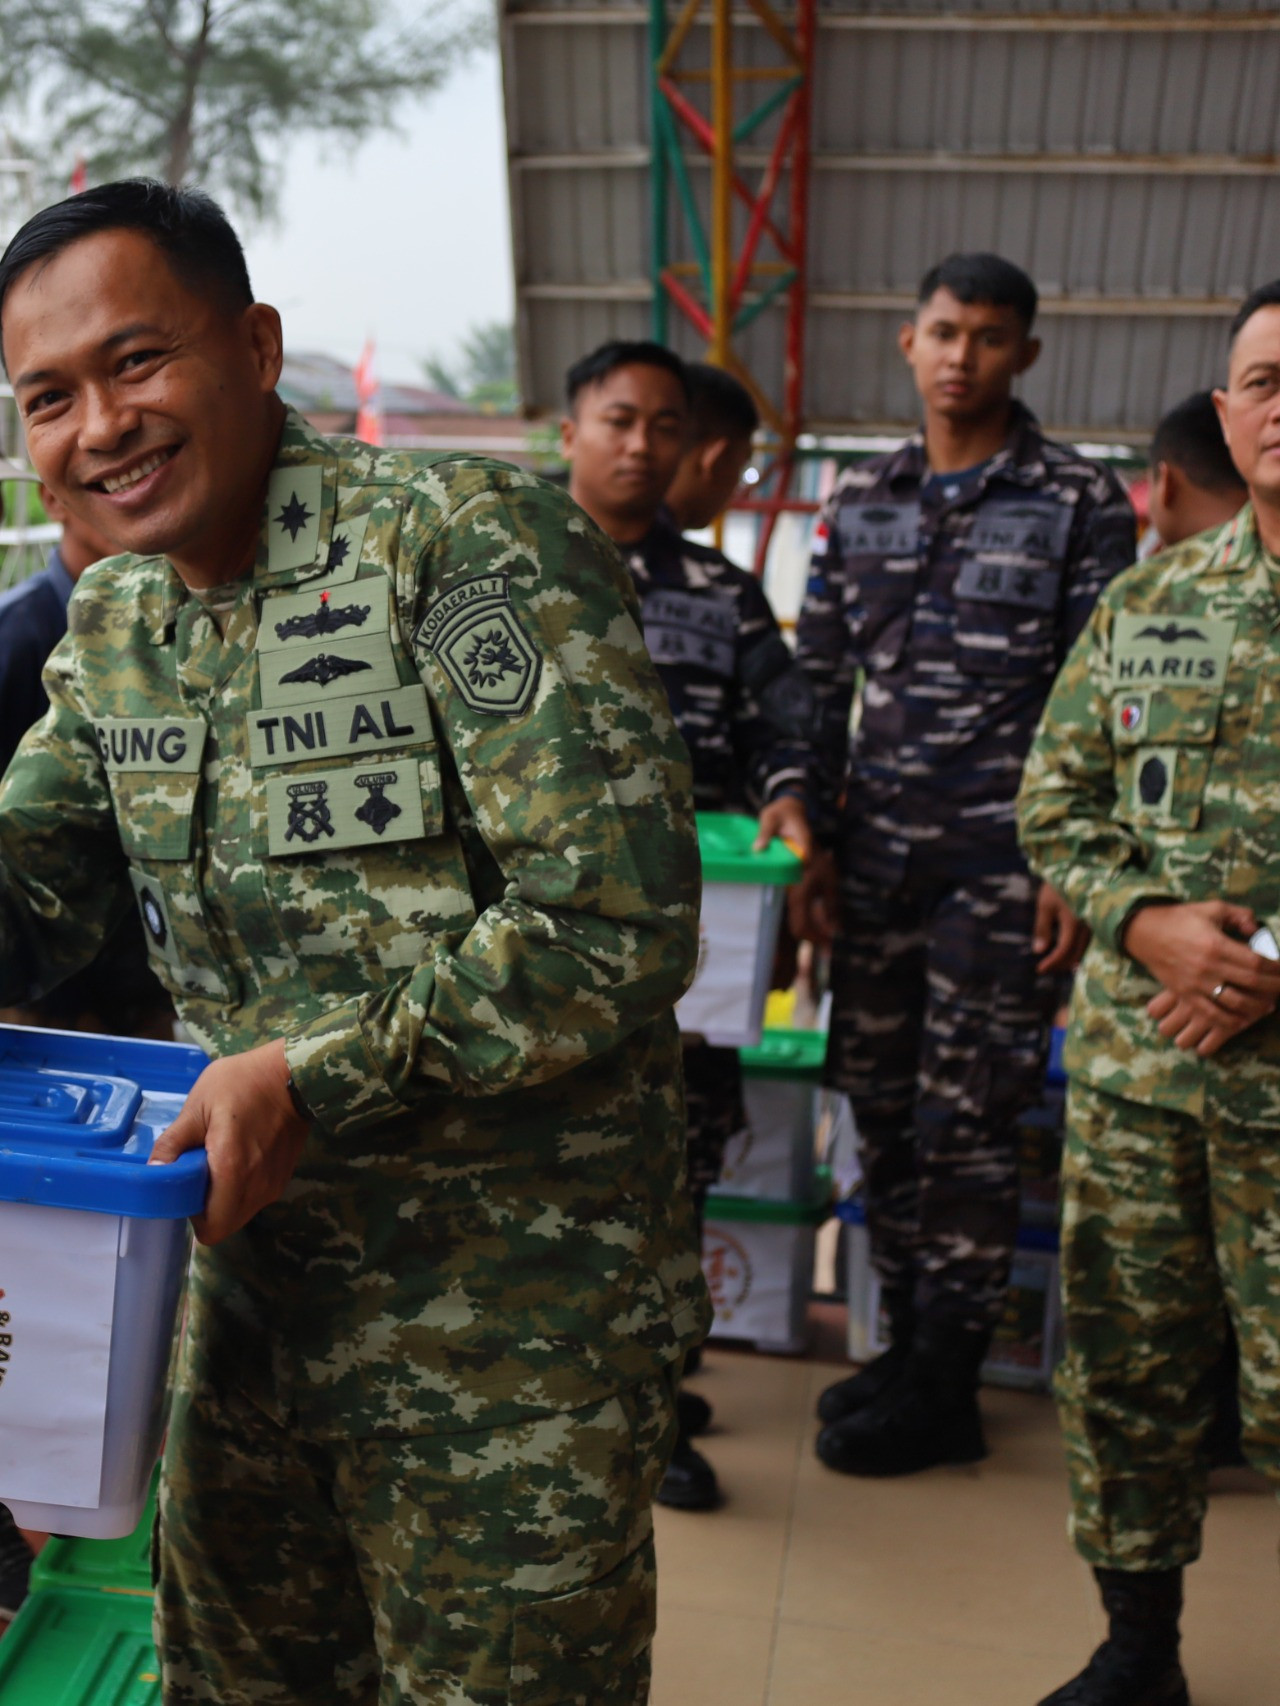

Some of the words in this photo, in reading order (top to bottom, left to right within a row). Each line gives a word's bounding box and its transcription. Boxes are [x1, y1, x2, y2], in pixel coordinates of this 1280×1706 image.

[420, 582, 488, 640] KODAERAL
[1119, 656, 1216, 679] HARIS
[256, 711, 327, 755] TNI
[348, 700, 414, 744] AL
